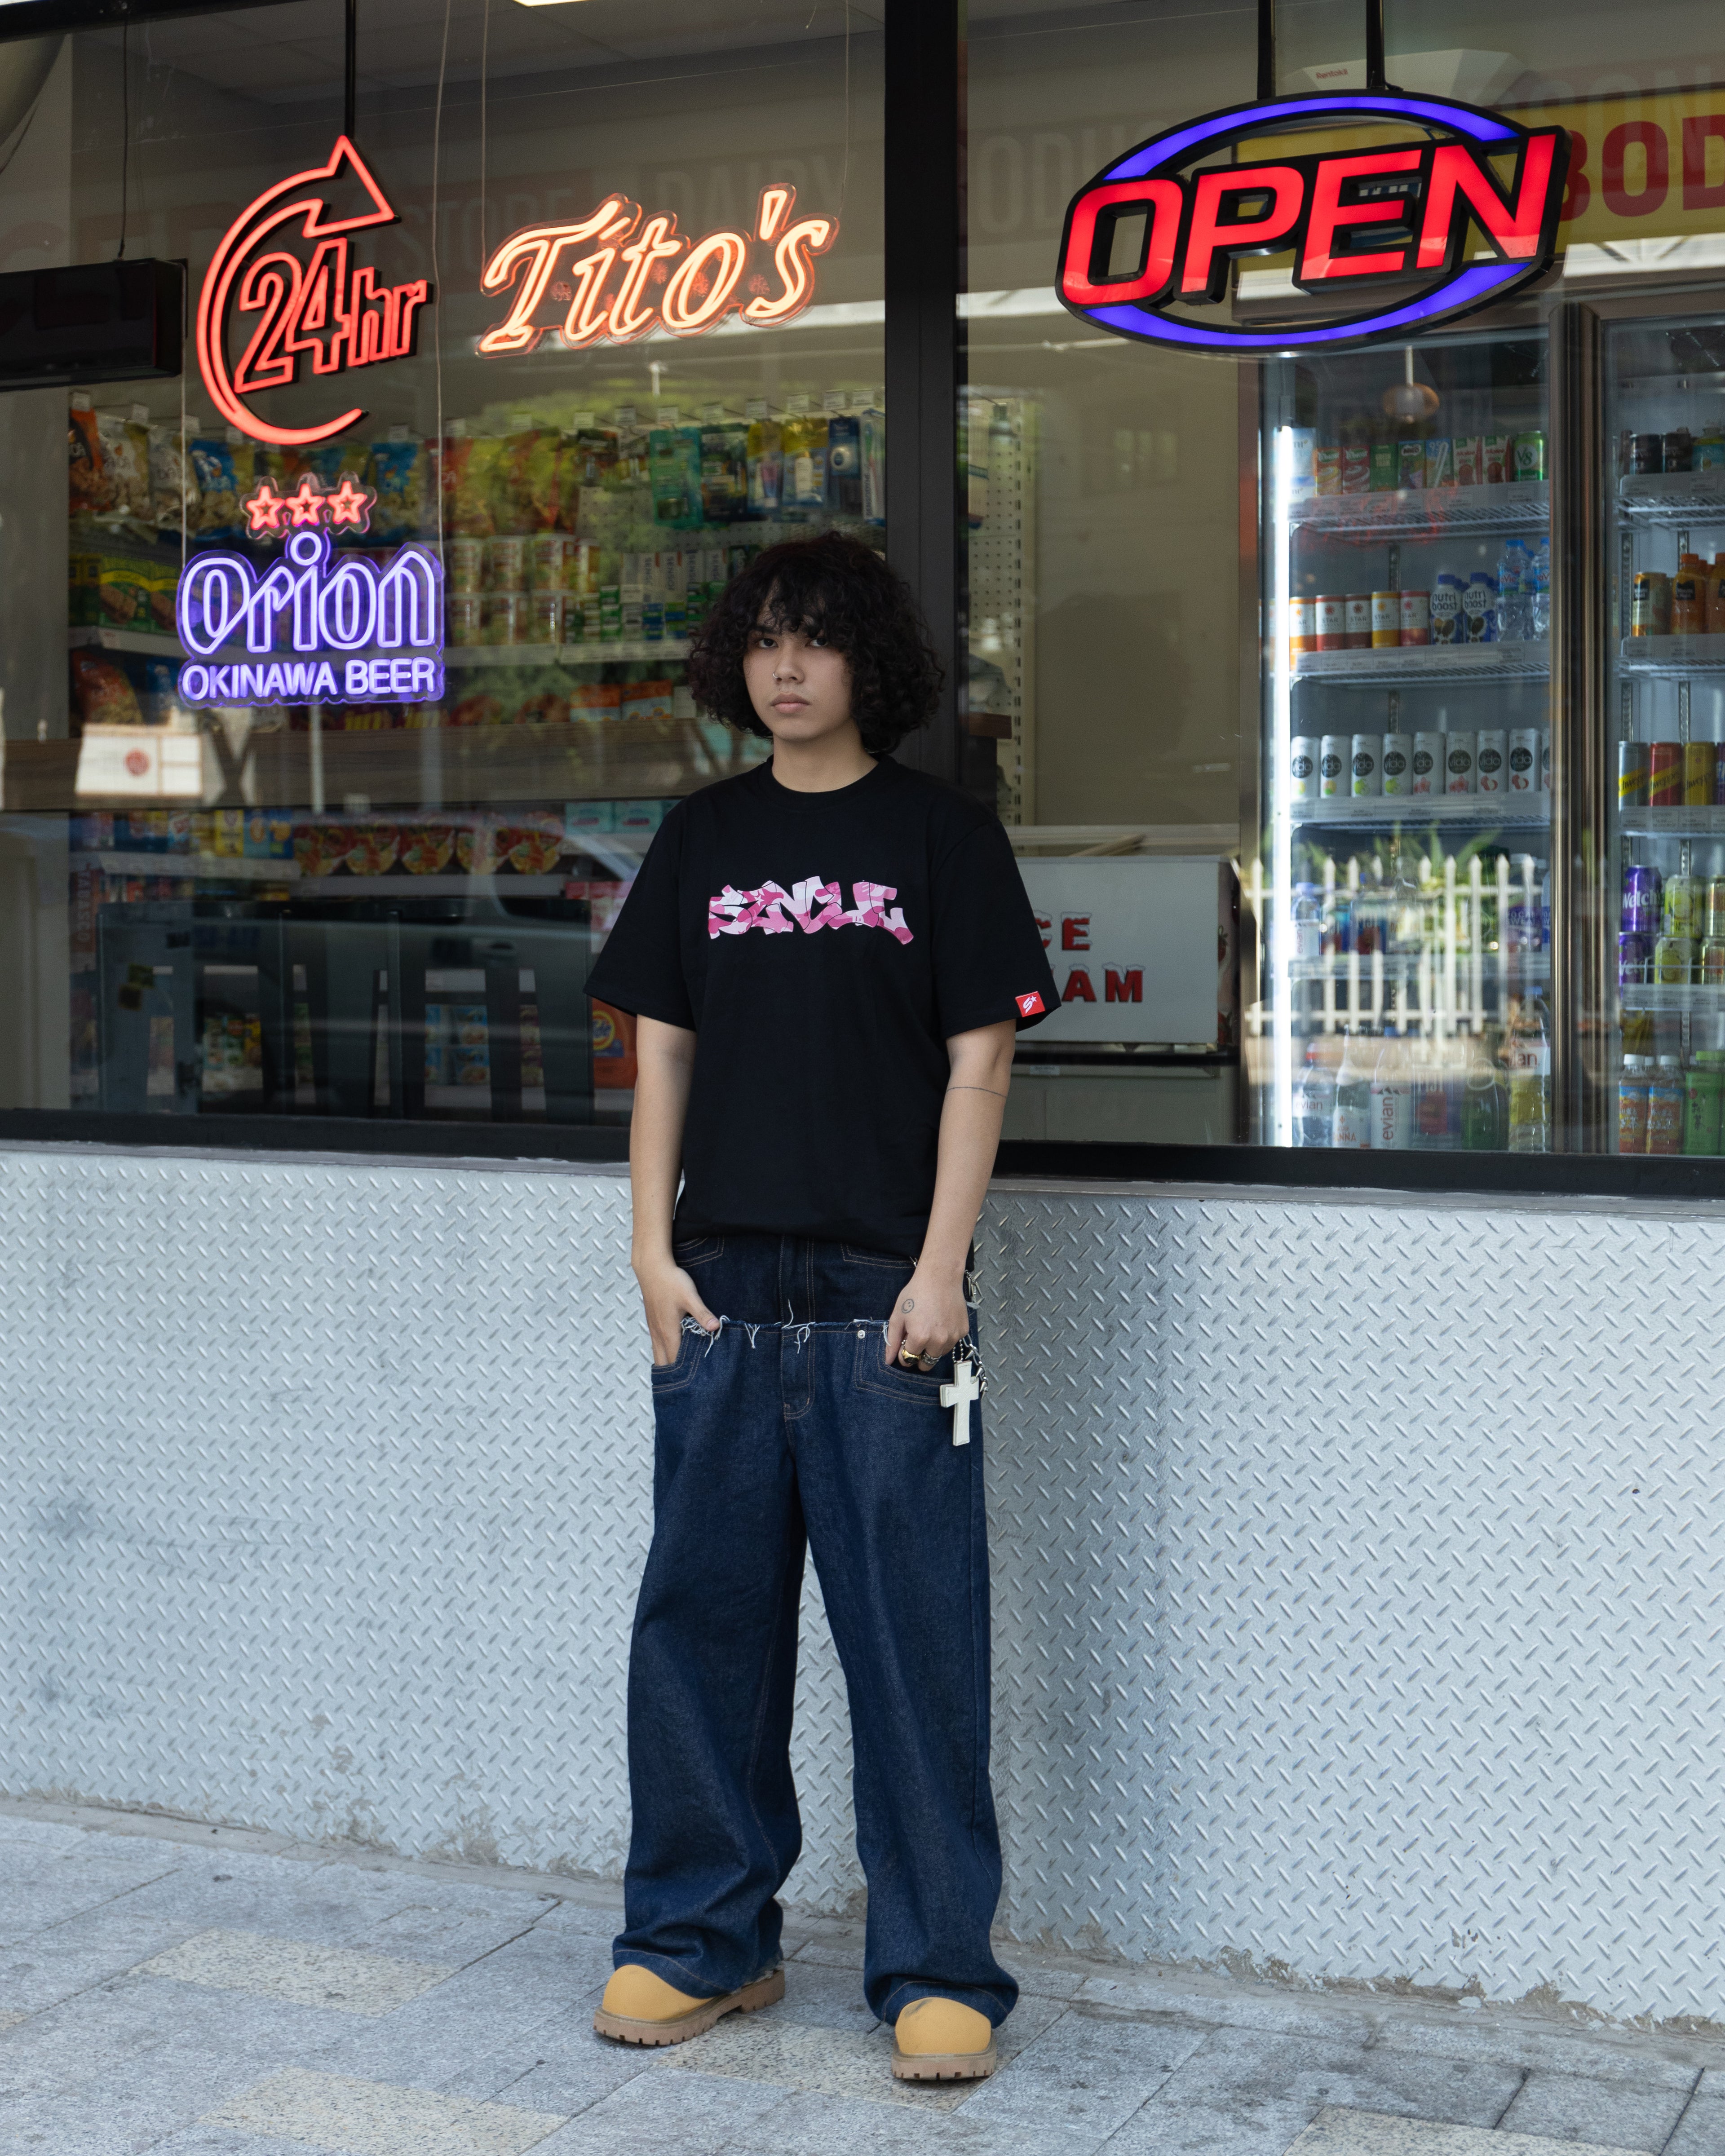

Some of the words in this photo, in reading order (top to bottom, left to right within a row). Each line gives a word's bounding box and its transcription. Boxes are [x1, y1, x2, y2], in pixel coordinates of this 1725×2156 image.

[1063, 133, 1557, 305] OPEN
[478, 189, 833, 353] Tito's
[234, 238, 428, 393] 24hr
[1517, 447, 1533, 466] V8
[182, 531, 435, 654] orion
[1432, 592, 1456, 602] nutri
[1432, 601, 1458, 611] boost
[1464, 591, 1486, 601] nutri
[1464, 599, 1487, 609] boost
[182, 661, 338, 700] OKINAWA
[345, 657, 435, 695] BEER
[1296, 1101, 1323, 1110] evian
[1380, 1096, 1394, 1140] evian
